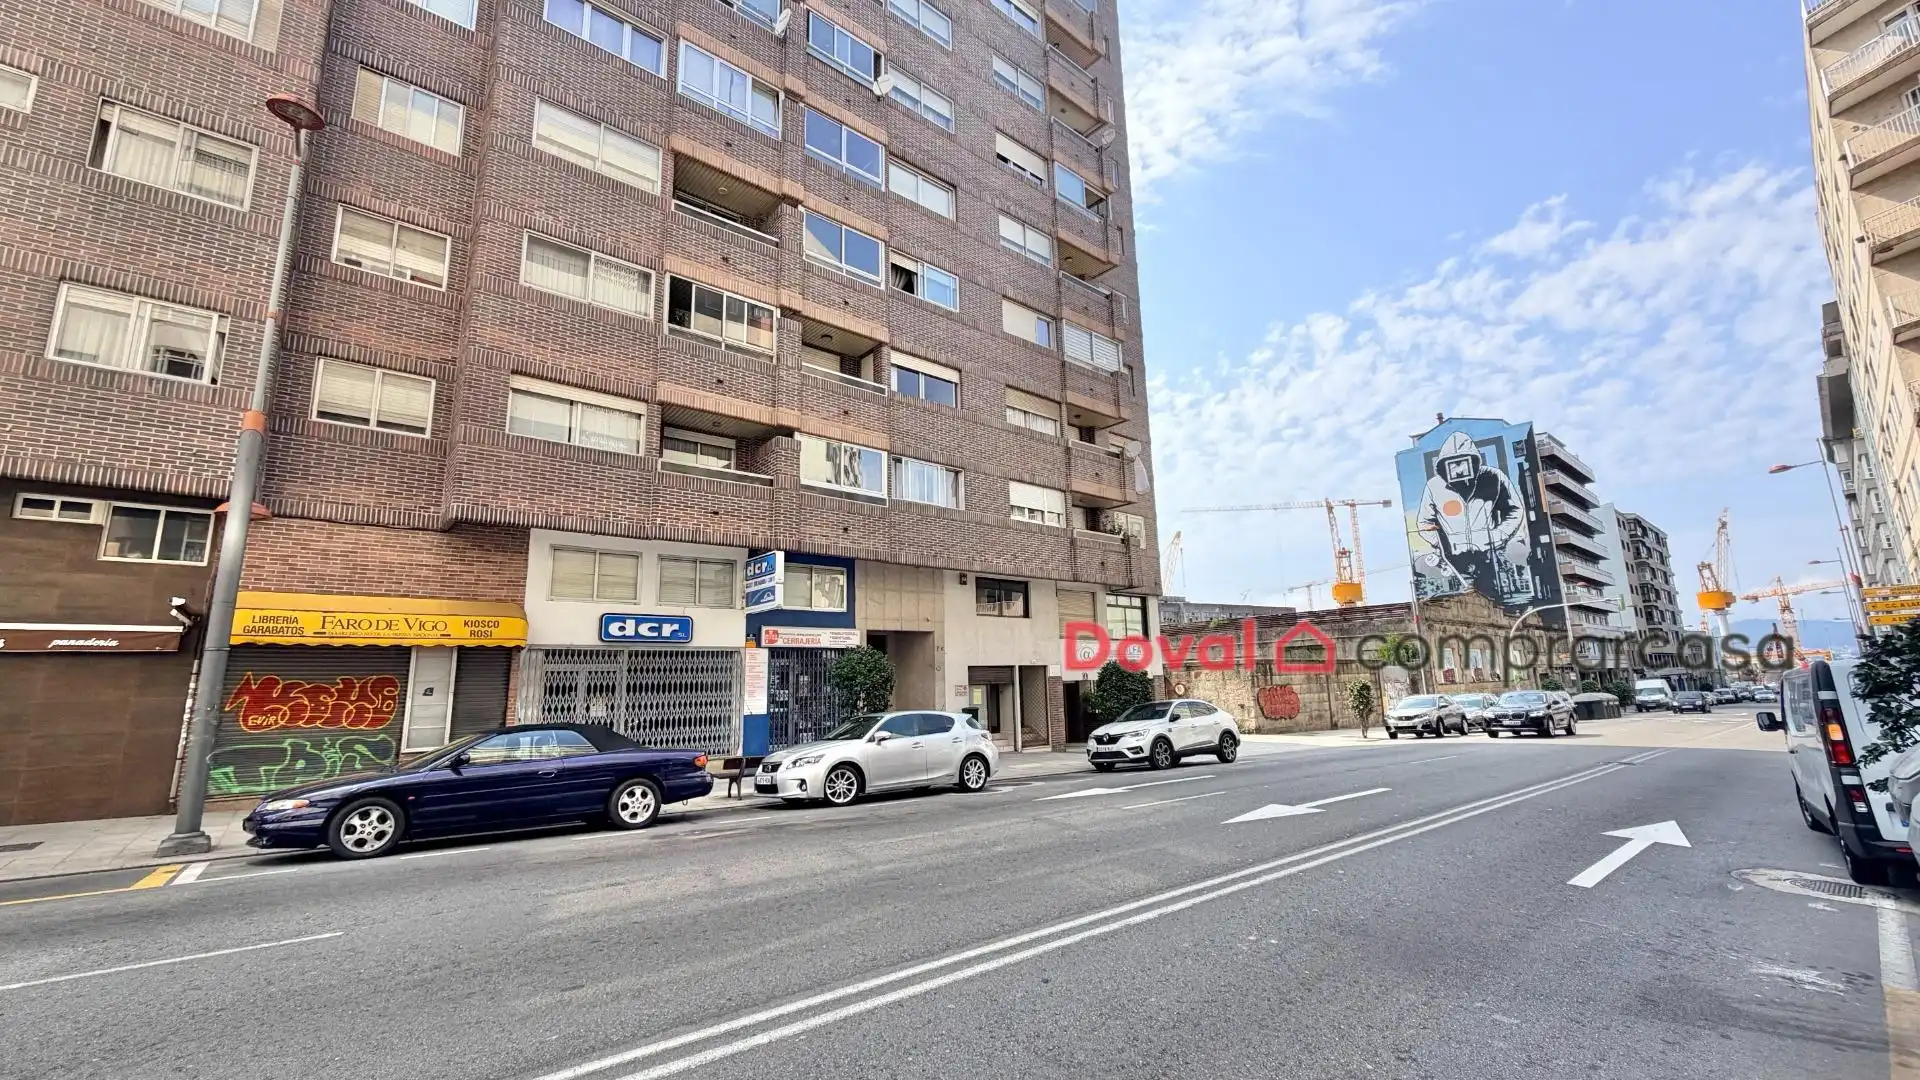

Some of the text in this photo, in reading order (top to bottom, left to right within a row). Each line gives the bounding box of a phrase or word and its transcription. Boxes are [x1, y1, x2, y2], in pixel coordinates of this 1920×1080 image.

[746, 561, 767, 576] dcr
[251, 615, 299, 625] LIBRERÍA
[320, 615, 448, 632] FARO DE VIGO
[463, 619, 500, 629] KIOSCO
[242, 625, 305, 635] GARABATOS
[608, 618, 679, 637] dcr
[469, 629, 493, 638] ROSI
